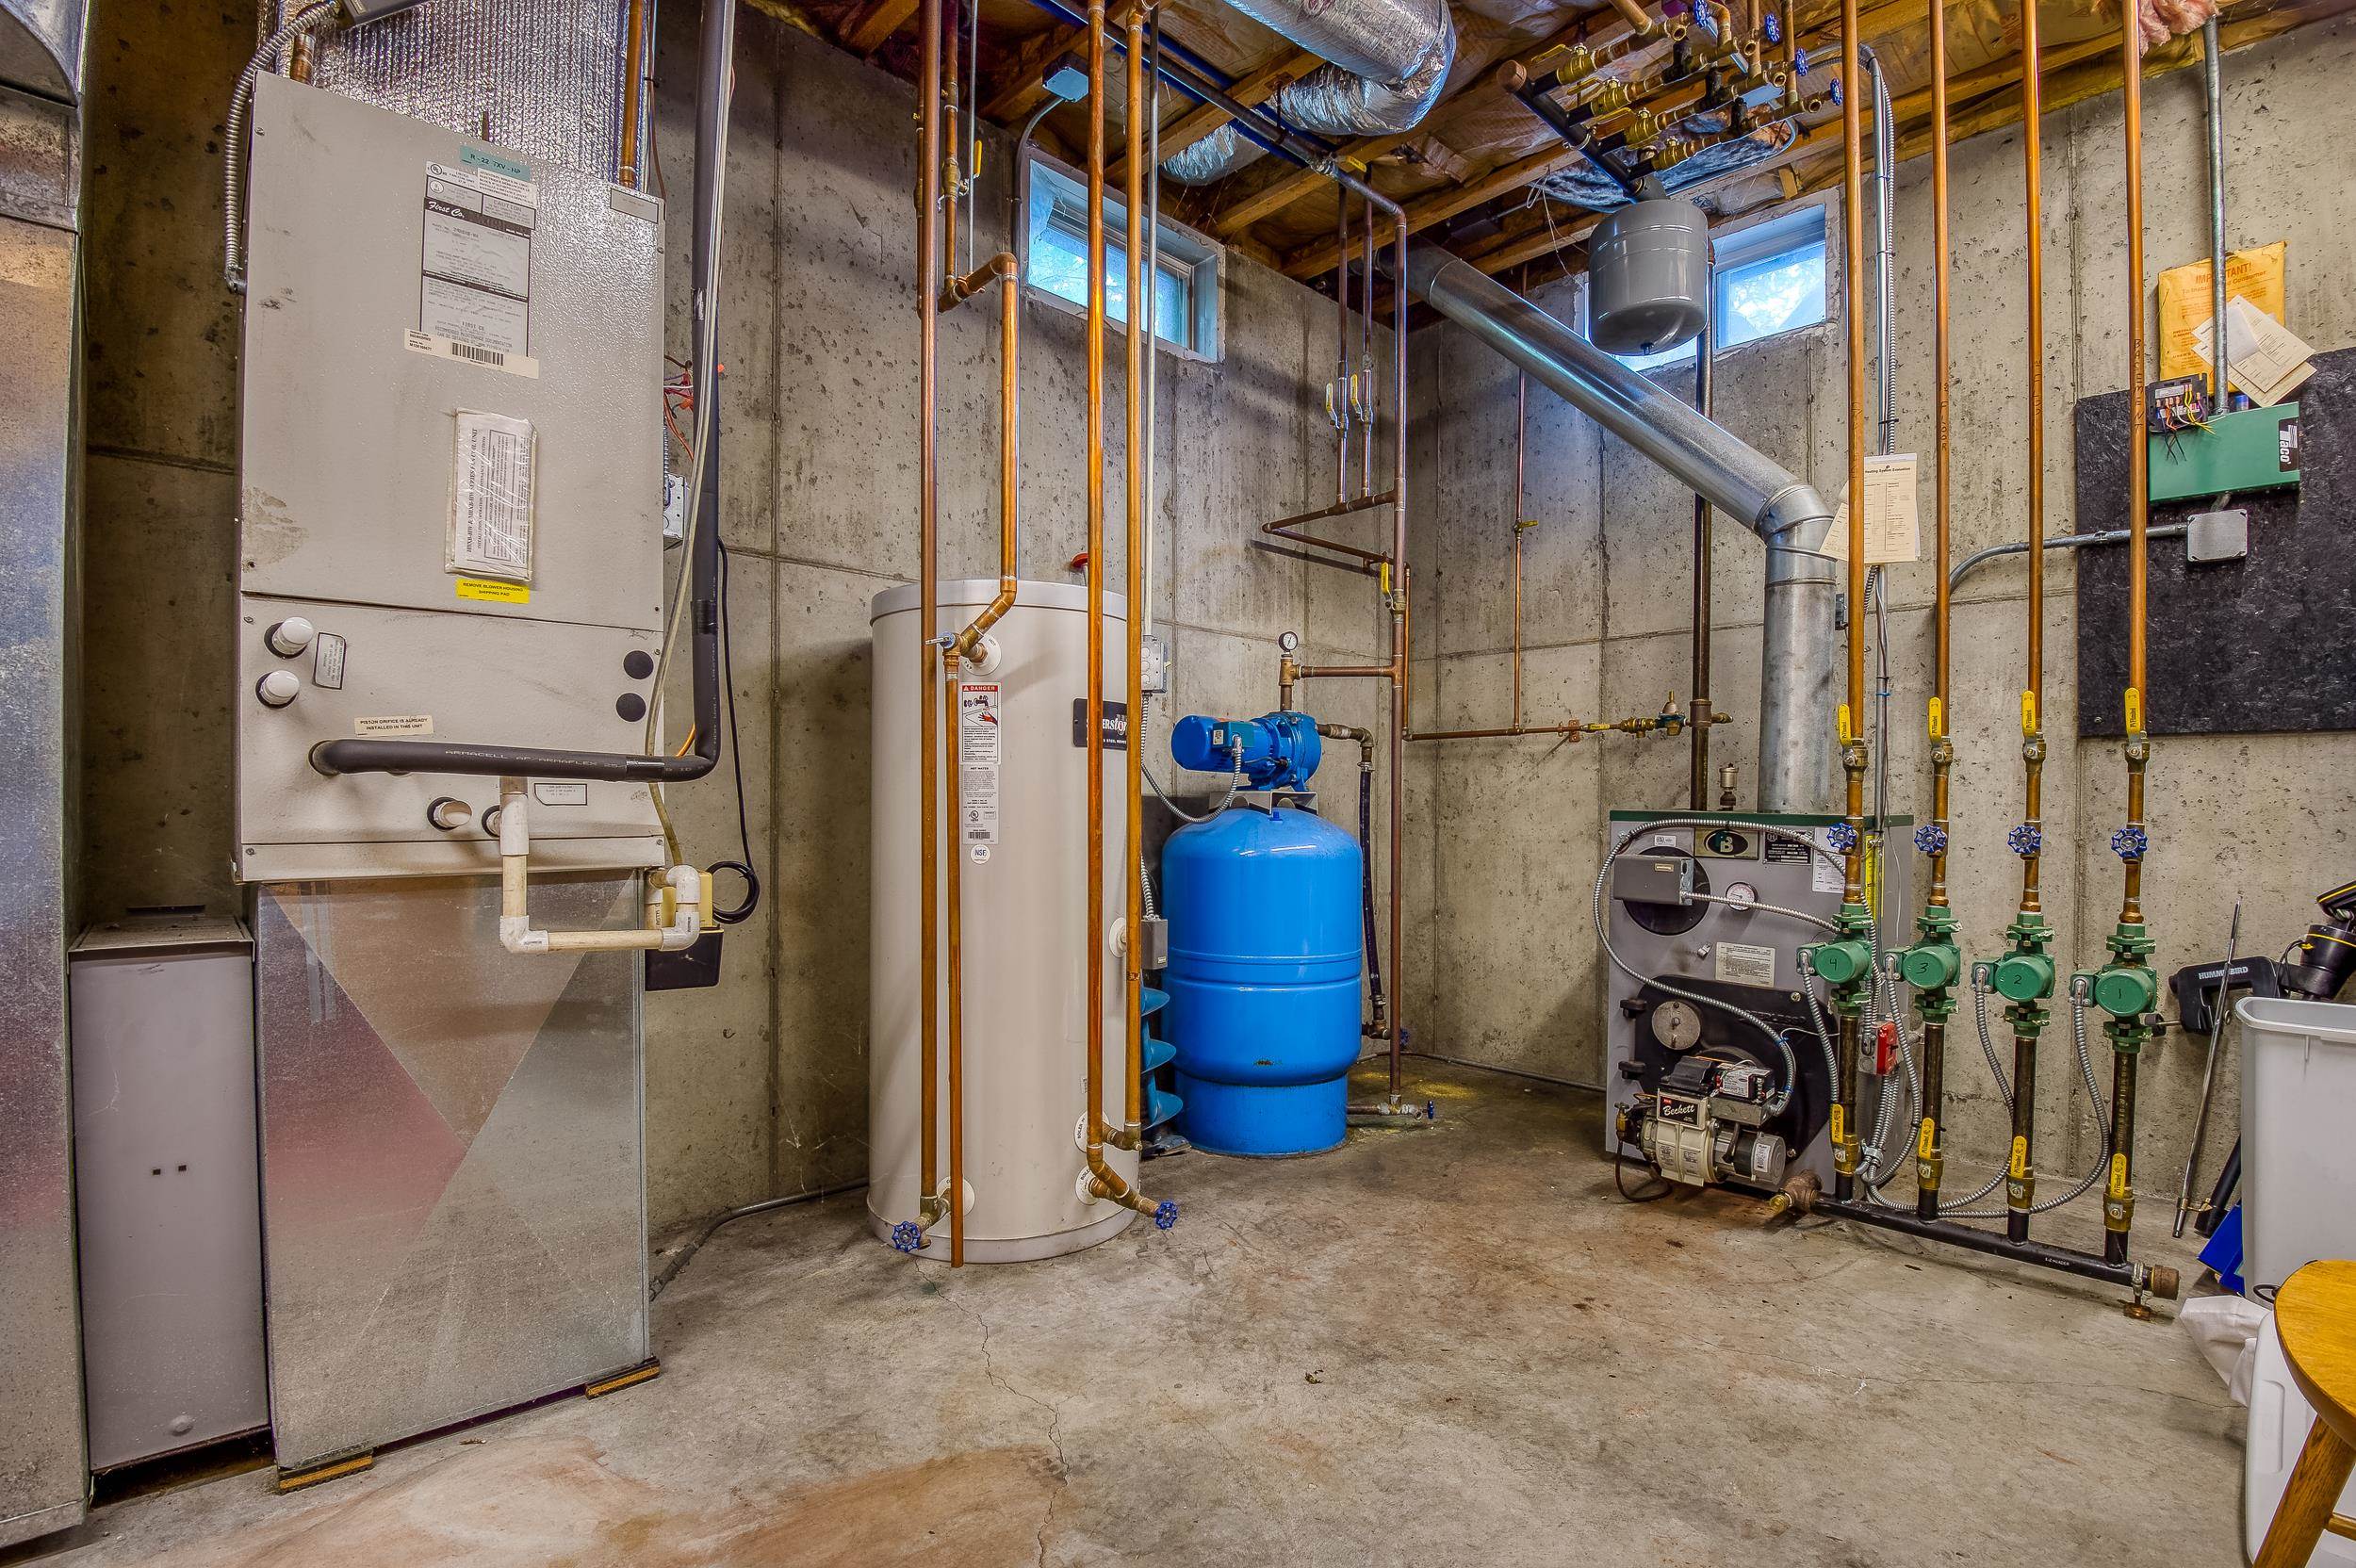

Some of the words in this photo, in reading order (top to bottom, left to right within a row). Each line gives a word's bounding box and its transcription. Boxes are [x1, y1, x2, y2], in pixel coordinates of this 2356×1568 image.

[470, 154, 489, 164] R-22
[428, 201, 450, 213] First
[2196, 263, 2251, 284] IMPTANT!
[2233, 270, 2266, 284] Consumer
[2280, 424, 2298, 462] Taco
[445, 750, 509, 760] ARMACELL
[1829, 957, 1838, 971] 4
[1916, 962, 1929, 974] 3
[2198, 966, 2249, 979] HUMMBIRD
[2013, 975, 2022, 986] 2
[1663, 1104, 1695, 1117] Beckett
